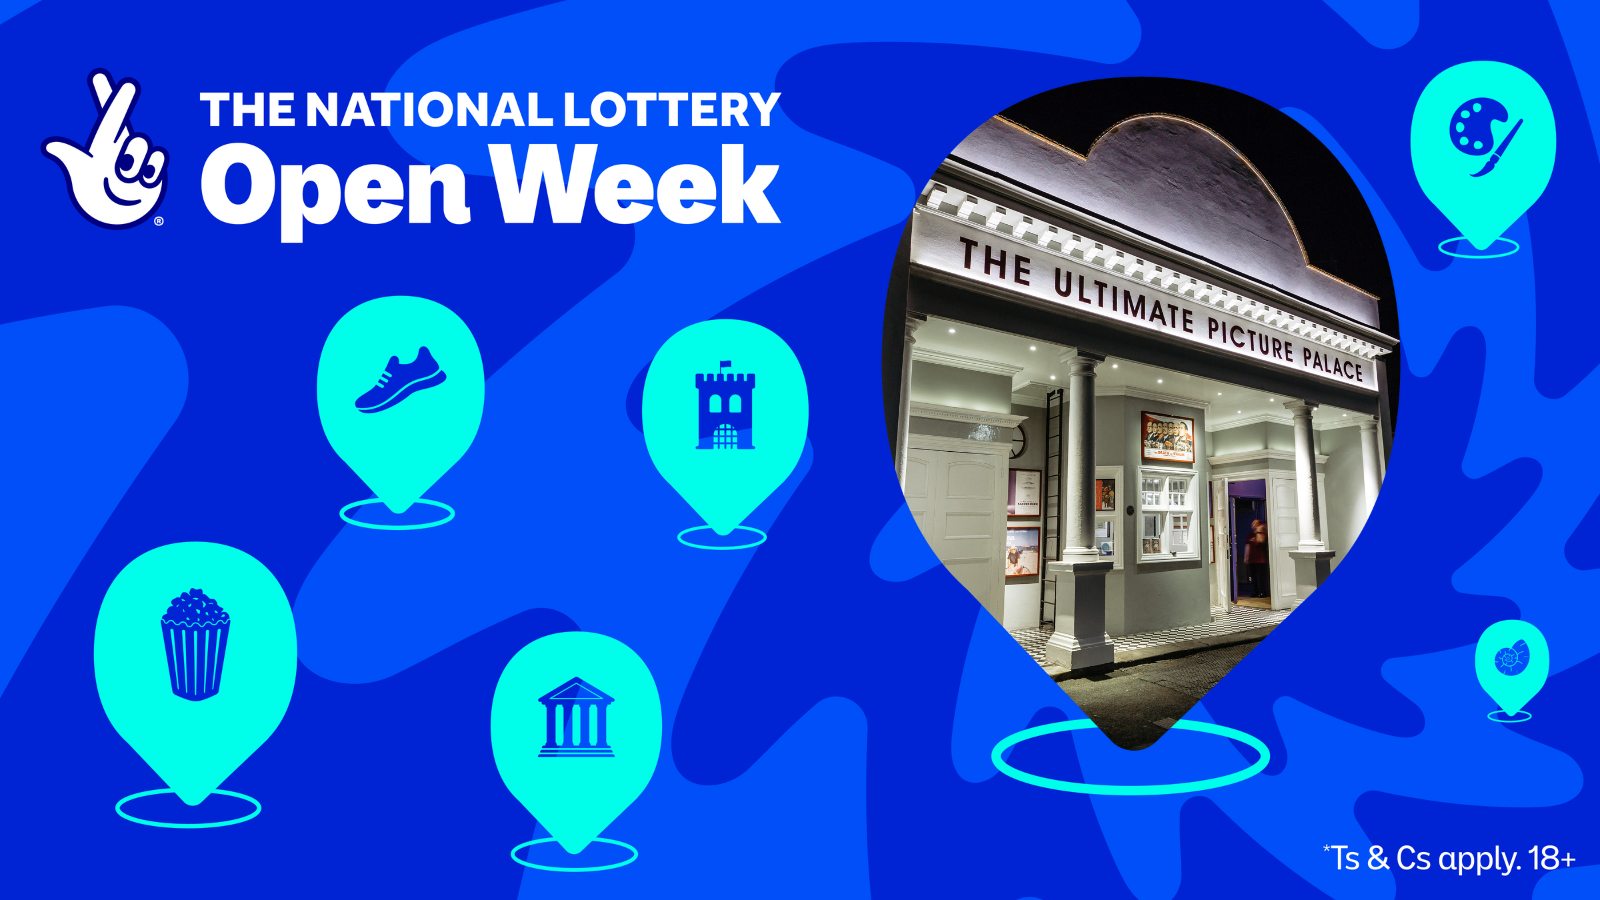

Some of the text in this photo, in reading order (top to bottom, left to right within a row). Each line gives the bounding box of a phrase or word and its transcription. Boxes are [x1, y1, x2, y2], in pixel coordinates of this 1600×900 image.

[959, 236, 1364, 383] THE ULTIMATE PICTURE PALACE
